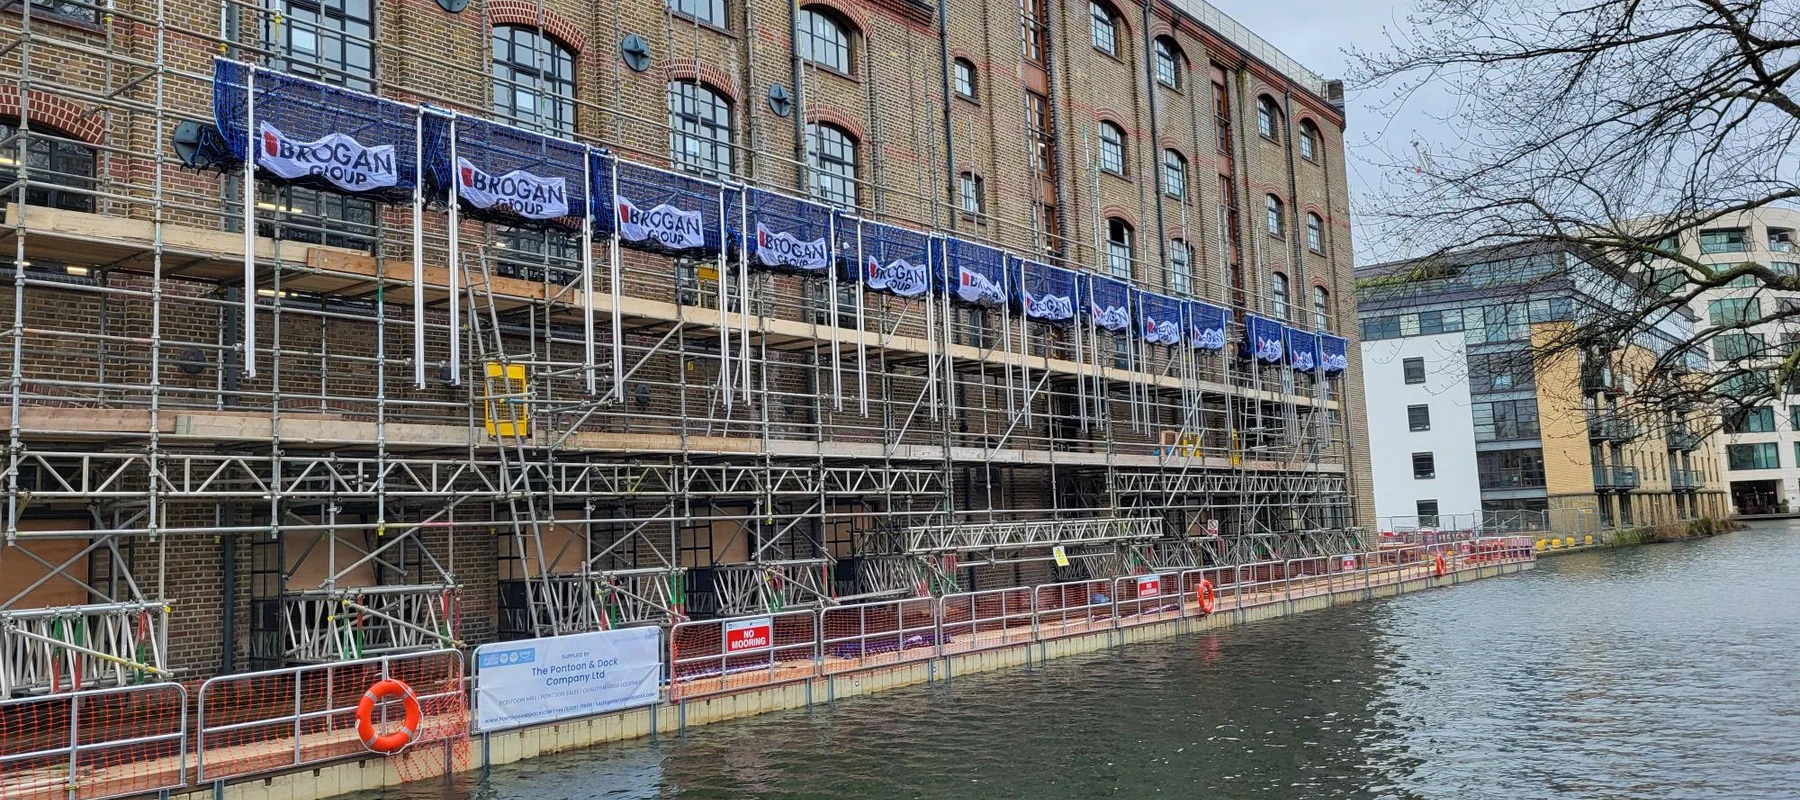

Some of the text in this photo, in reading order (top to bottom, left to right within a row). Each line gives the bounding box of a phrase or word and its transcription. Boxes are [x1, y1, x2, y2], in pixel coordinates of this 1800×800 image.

[279, 140, 393, 175] BROGAN
[473, 170, 565, 205] BROGAN
[630, 208, 700, 236] BROGAN
[765, 234, 825, 260] BROGAN
[731, 637, 766, 650] MOORING
[743, 629, 755, 639] NO
[531, 657, 618, 676] The Pontoon & Dock
[546, 670, 605, 686] Company Ltd
